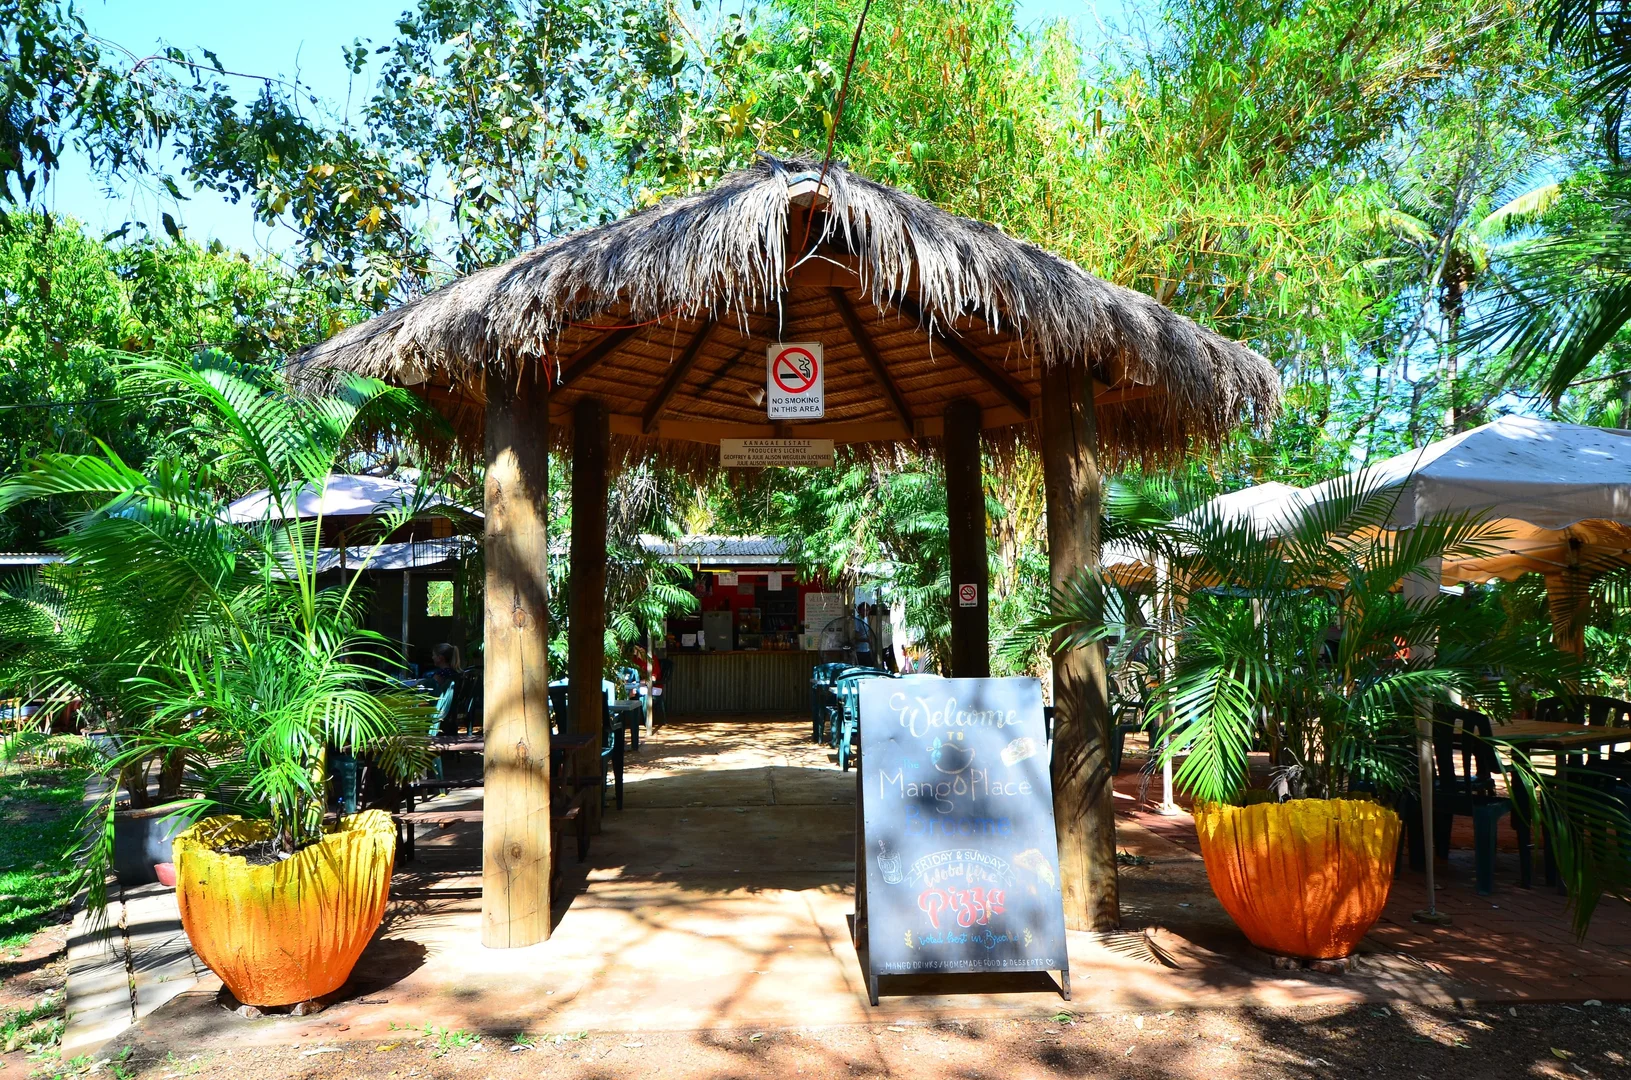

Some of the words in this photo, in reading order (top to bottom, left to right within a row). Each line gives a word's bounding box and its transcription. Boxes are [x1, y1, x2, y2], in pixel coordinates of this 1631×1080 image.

[889, 692, 1023, 738] Welcome
[879, 767, 967, 814] Mango
[970, 767, 1033, 802] Place
[903, 805, 1012, 837] Broome
[914, 851, 953, 876] FRIDAY
[956, 850, 963, 861] &
[964, 851, 1006, 870] SUNDAY
[917, 886, 1007, 929] Pizza
[885, 961, 911, 970] MANGO
[1009, 958, 1044, 967] DESSERTS
